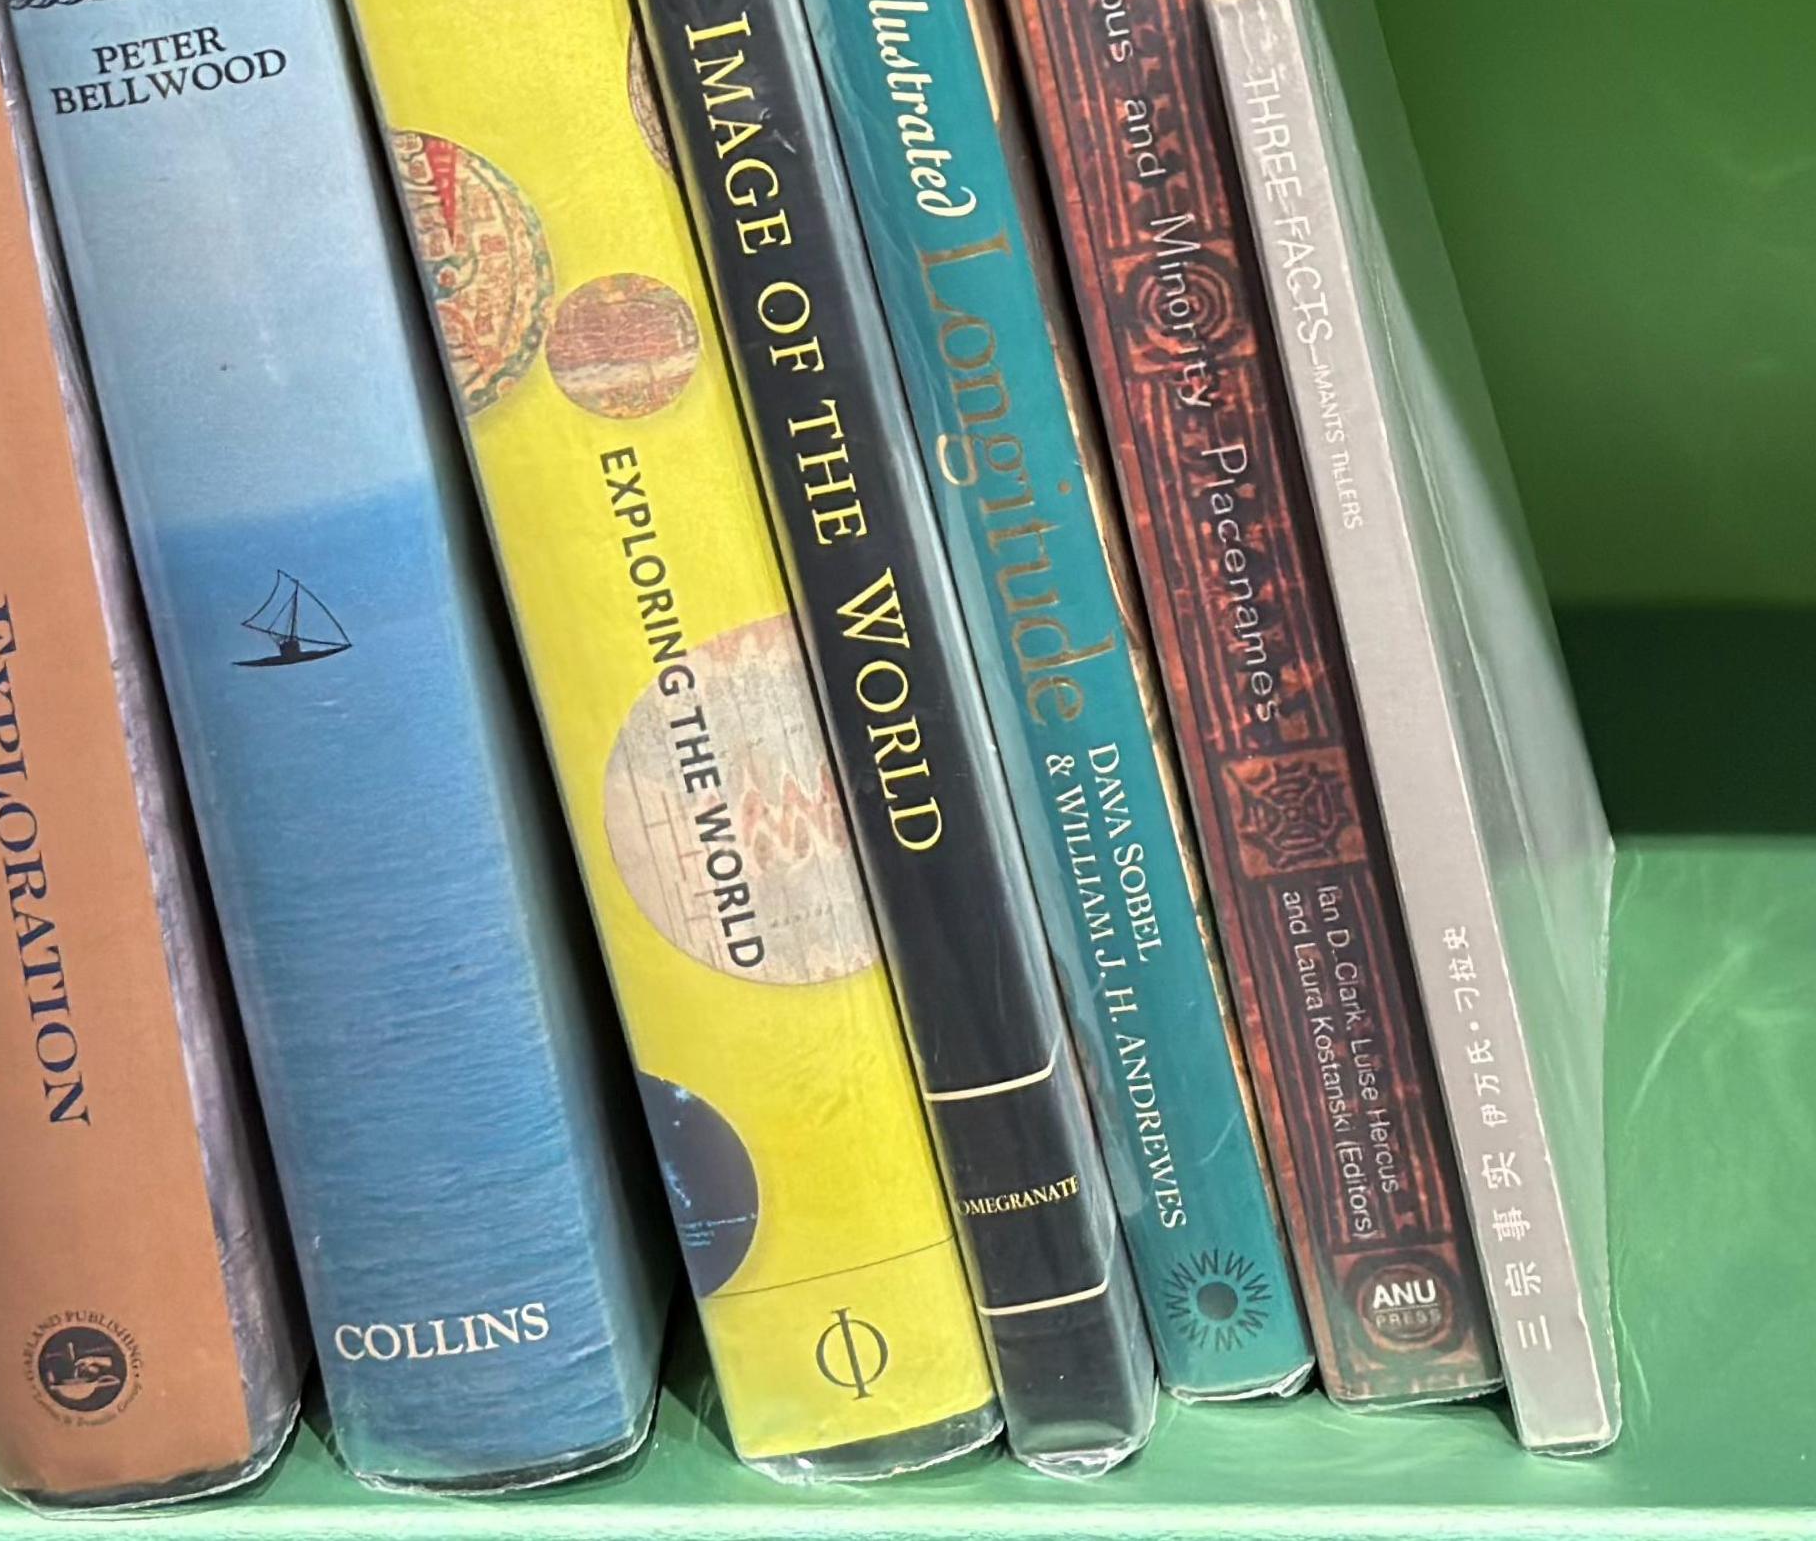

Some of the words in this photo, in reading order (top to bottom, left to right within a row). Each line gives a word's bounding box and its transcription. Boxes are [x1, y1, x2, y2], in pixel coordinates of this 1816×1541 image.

[52, 46, 288, 117] BELLWOOD
[93, 25, 227, 75] PETER
[686, 11, 794, 255] IMAGE
[756, 280, 826, 375] OF
[1243, 68, 1303, 202] THREE
[1331, 449, 1364, 531] TILLERS
[1123, 97, 1166, 178] and
[1150, 212, 1213, 409] Minority
[1201, 441, 1284, 724] Placenames
[787, 399, 869, 547] THE
[917, 231, 1122, 728] Longitude
[598, 446, 696, 697] EXPLORING
[670, 705, 722, 794] THE
[836, 567, 943, 853] WORLD
[1045, 754, 1075, 777] &
[695, 802, 765, 968] WORLD
[1052, 783, 1119, 945] WILLIAM
[1087, 742, 1135, 837] DAVA
[1113, 840, 1163, 962] SOBEL
[1283, 891, 1312, 935] and
[1294, 942, 1324, 1011] Laura
[1310, 1016, 1356, 1133] Kostanski
[1317, 886, 1340, 923] Ian
[1351, 1038, 1380, 1101] Luise
[1367, 1109, 1400, 1194] Hercus
[1116, 1034, 1187, 1229] ANDREWES
[959, 1175, 1080, 1215] OMEGRANATE
[1336, 1141, 1379, 1240] (Editors)
[334, 1302, 550, 1363] COLLINS
[1373, 1279, 1436, 1309] ANU
[1375, 1308, 1442, 1329] PRESS
